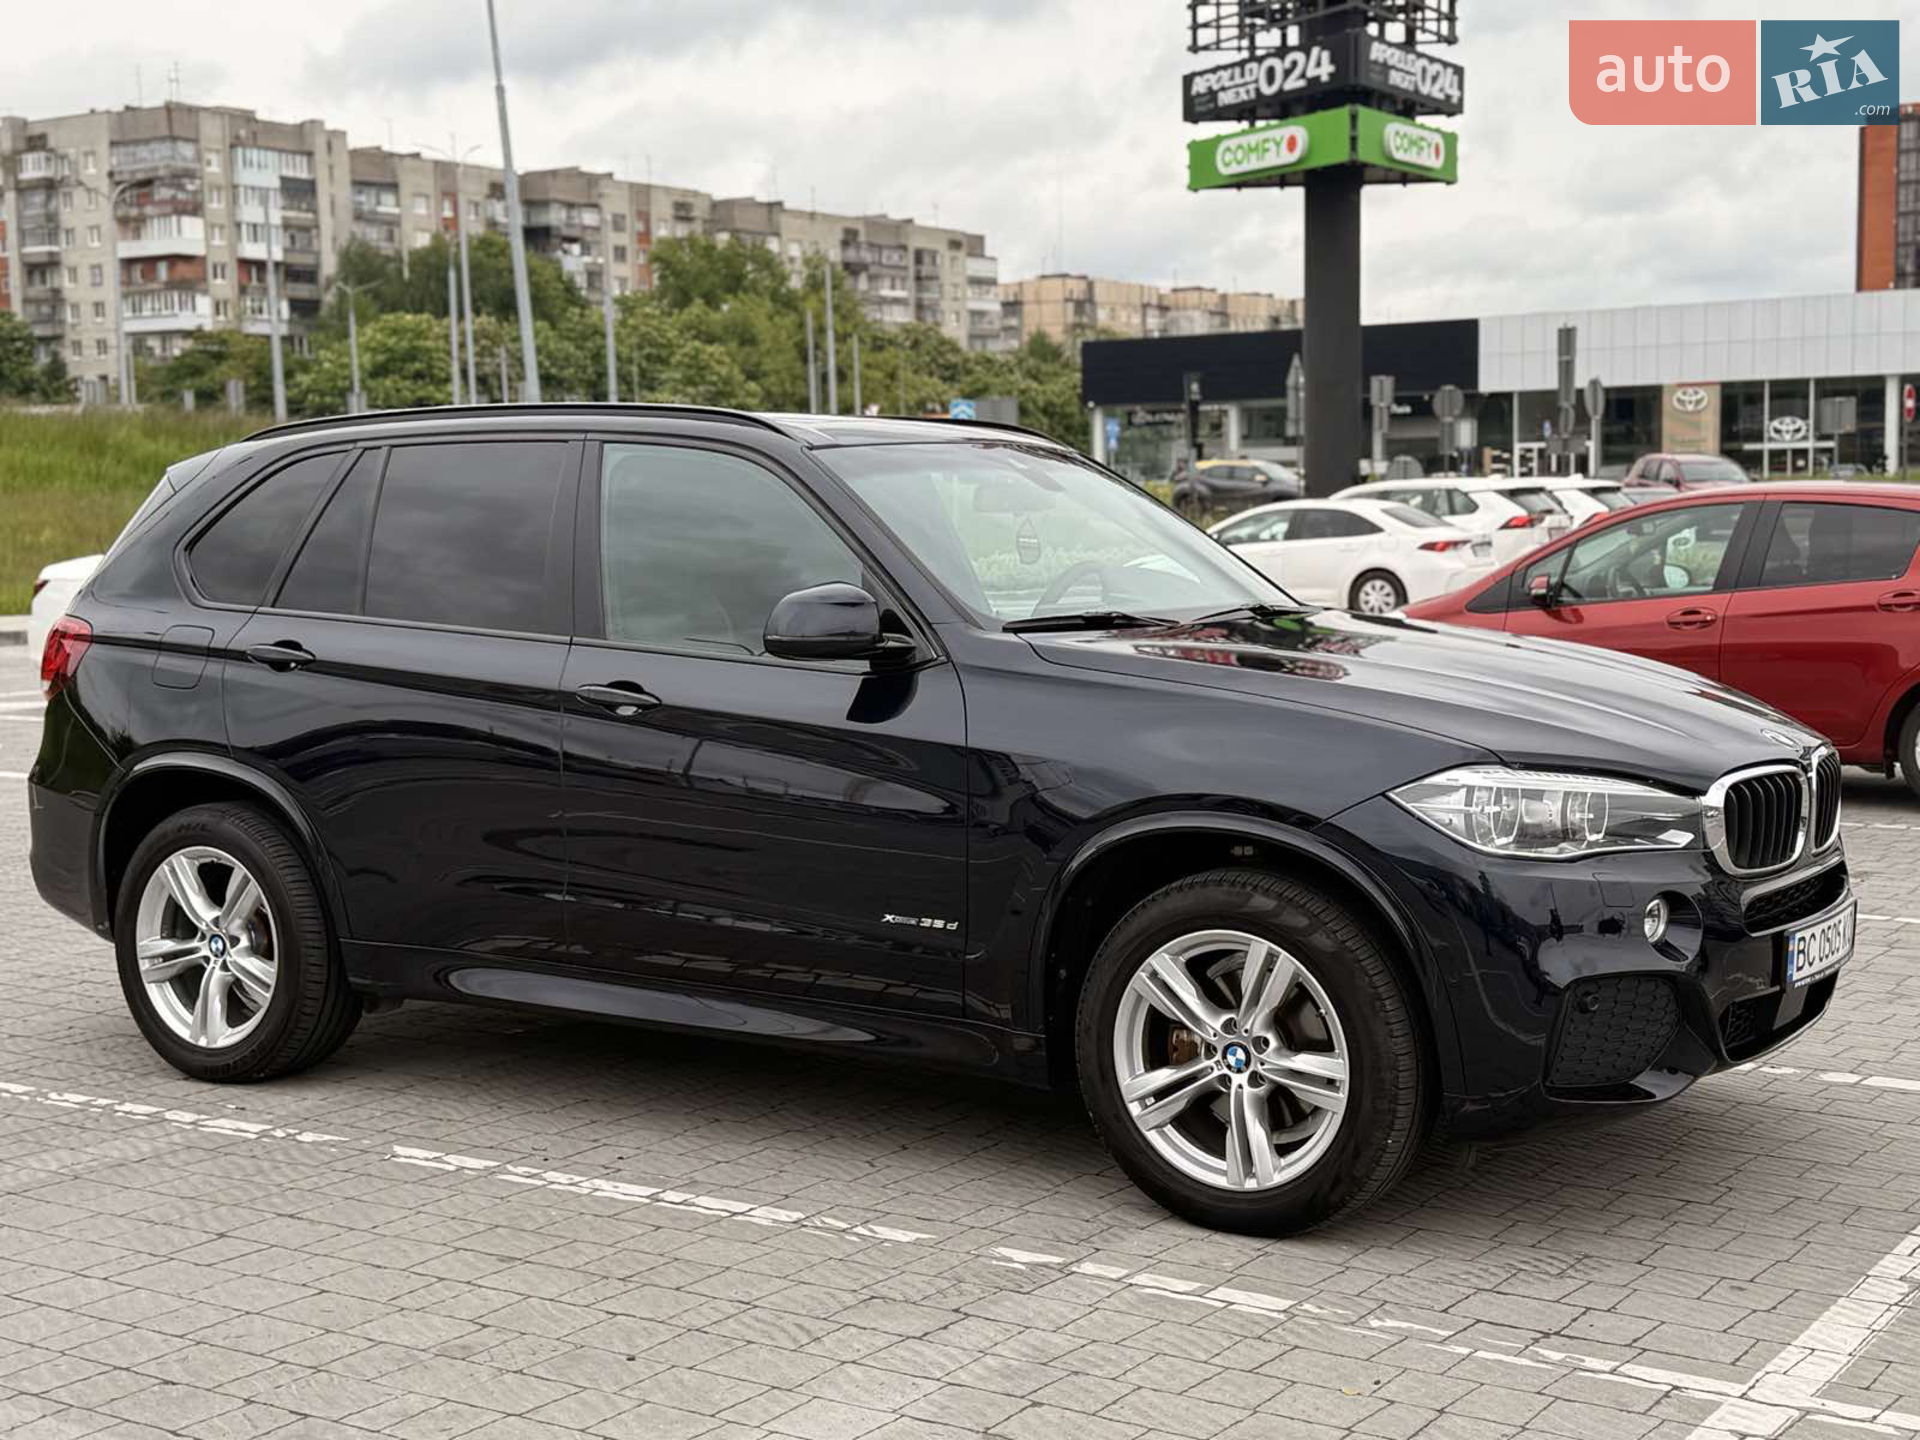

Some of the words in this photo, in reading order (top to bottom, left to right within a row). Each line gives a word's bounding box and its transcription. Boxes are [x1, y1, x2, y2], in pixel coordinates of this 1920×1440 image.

[1191, 62, 1259, 96] APOLLO
[1258, 46, 1335, 96] 024
[1415, 57, 1461, 104] 024
[1217, 82, 1257, 107] NEXT
[1221, 134, 1284, 168] COMFY
[1395, 130, 1434, 160] COMFY
[1796, 933, 1817, 972] BC
[1819, 920, 1842, 962] 0505
